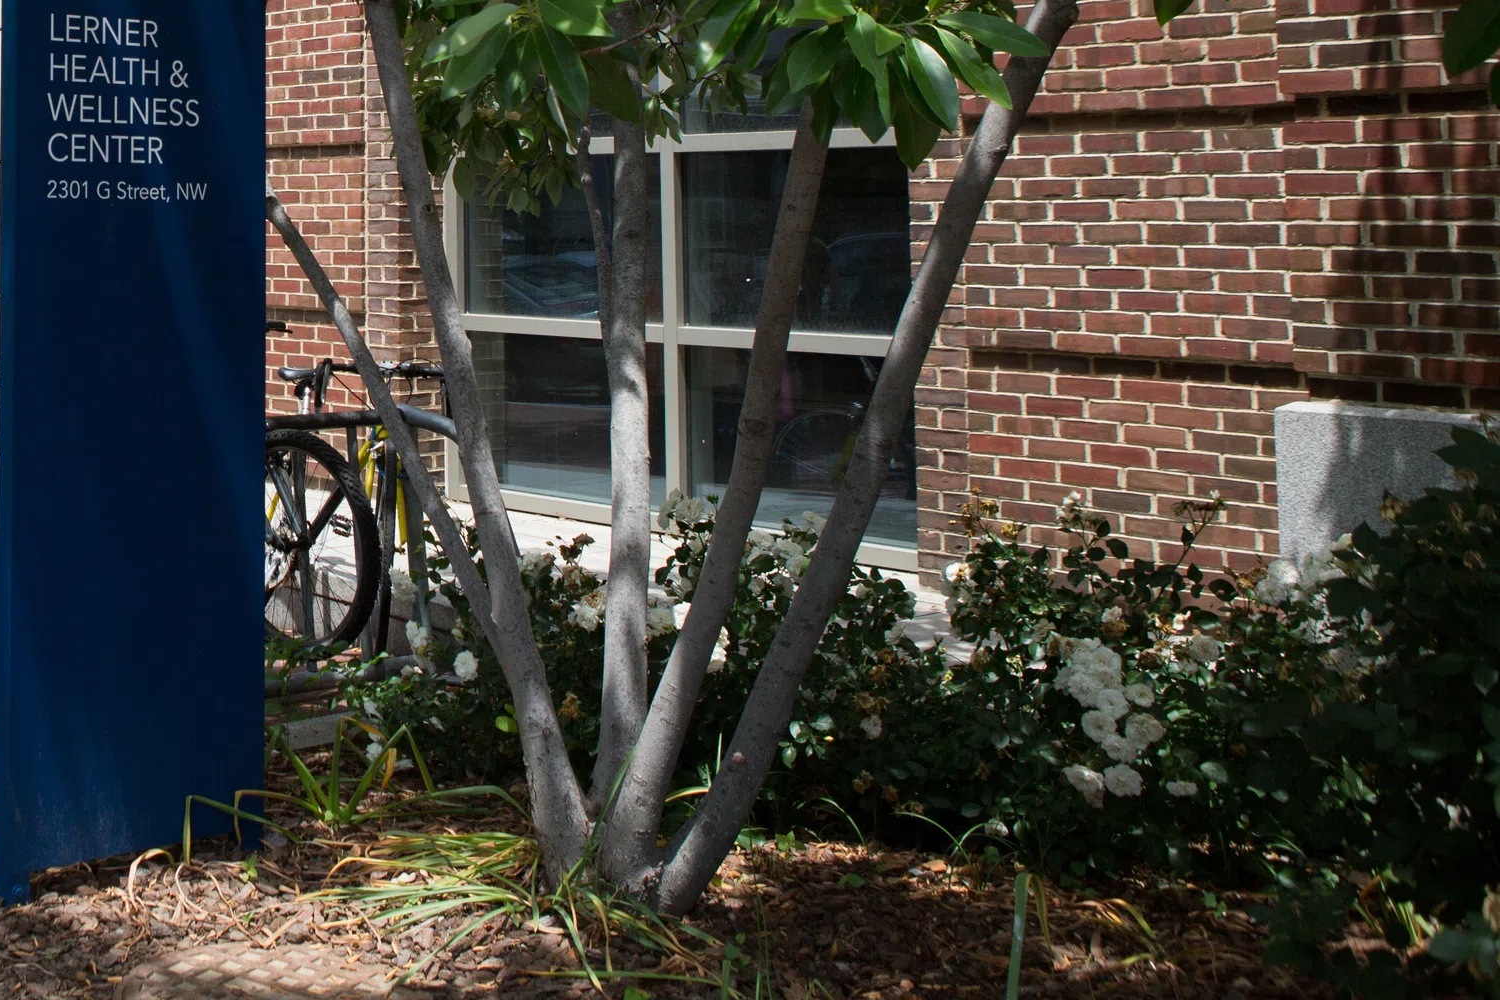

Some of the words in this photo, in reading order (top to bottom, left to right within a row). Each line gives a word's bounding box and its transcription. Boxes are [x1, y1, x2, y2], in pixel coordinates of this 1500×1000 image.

[50, 13, 159, 48] LERNER
[50, 53, 159, 87] HEALTH
[169, 60, 189, 88] &
[47, 92, 200, 127] WELLNESS
[47, 132, 164, 165] CENTER
[47, 180, 88, 199] 2301
[96, 181, 110, 199] G
[117, 181, 170, 203] Street,
[176, 183, 207, 200] NW
